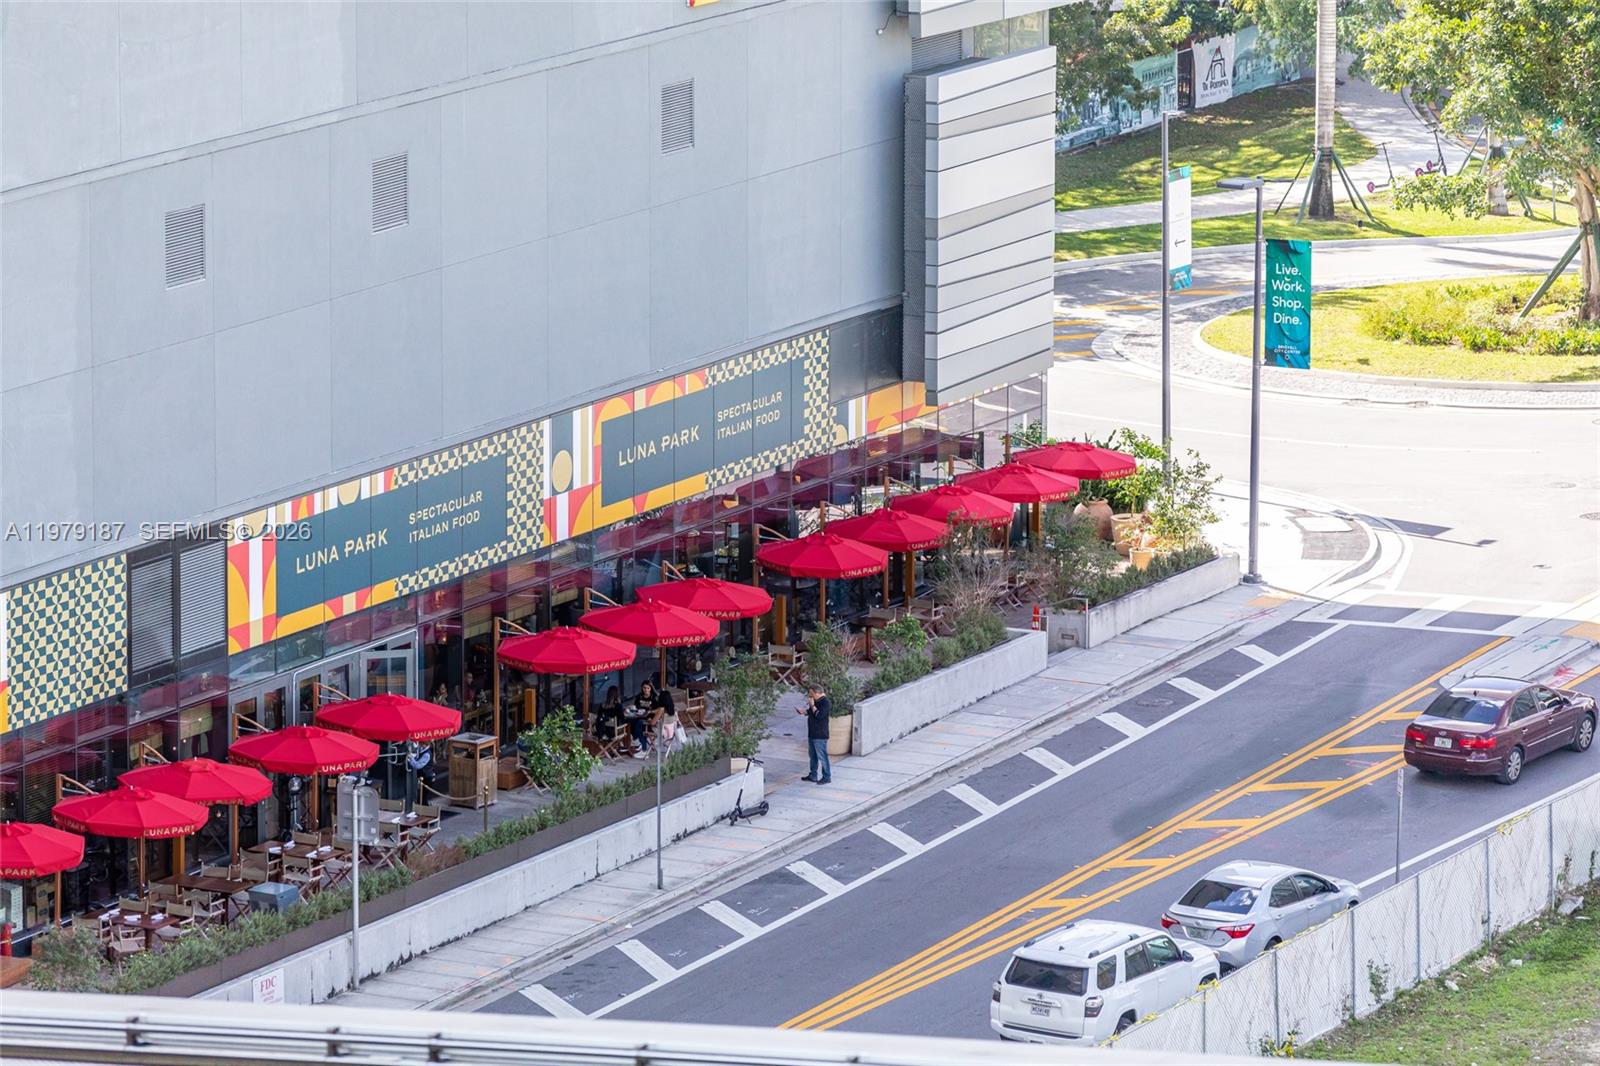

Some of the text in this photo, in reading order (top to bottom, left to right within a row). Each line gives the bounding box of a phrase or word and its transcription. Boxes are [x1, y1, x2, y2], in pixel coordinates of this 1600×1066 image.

[1275, 263, 1301, 275] Live.
[1271, 279, 1305, 292] Work.
[1272, 296, 1304, 311] Shop.
[1273, 312, 1302, 325] Dine.
[717, 391, 783, 422] SPECTACULAR
[717, 409, 781, 440] ITALIAN FOOD
[618, 425, 700, 467] LUNA PARK
[408, 490, 483, 525] SPECTACULAR
[408, 510, 481, 544] ITALIAN FOOD
[296, 528, 389, 574] LUNA PARK
[840, 569, 862, 577] LUNA
[715, 610, 741, 618] PARK
[656, 636, 706, 647] LUNA PARK
[5, 868, 36, 876] PARK
[260, 976, 277, 992] FDC
